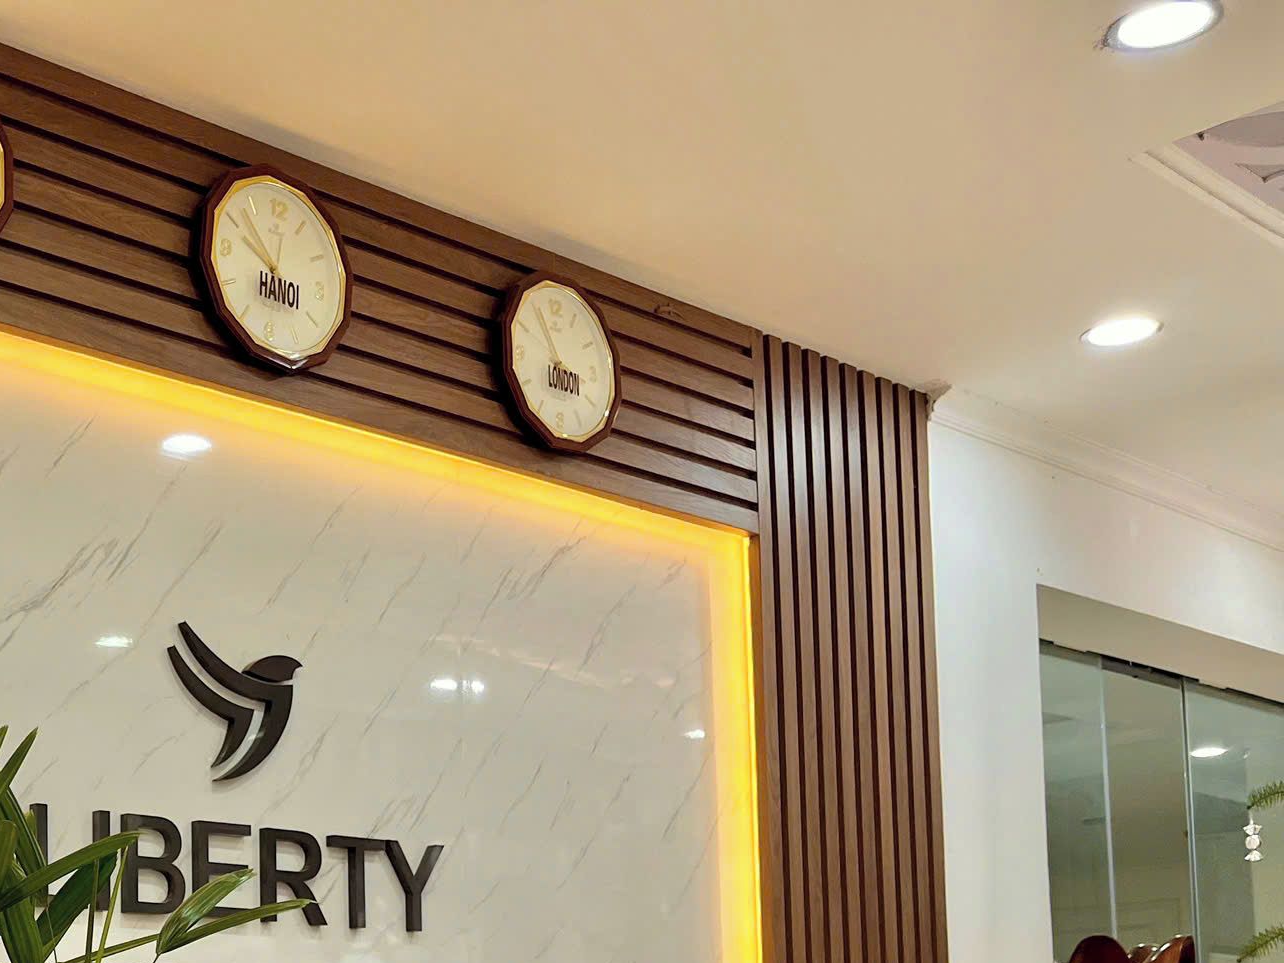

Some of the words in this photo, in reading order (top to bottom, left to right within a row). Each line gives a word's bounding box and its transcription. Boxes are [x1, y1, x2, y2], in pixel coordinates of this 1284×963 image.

[268, 197, 289, 221] 12
[258, 270, 300, 310] HANOI
[547, 364, 580, 397] LONDON
